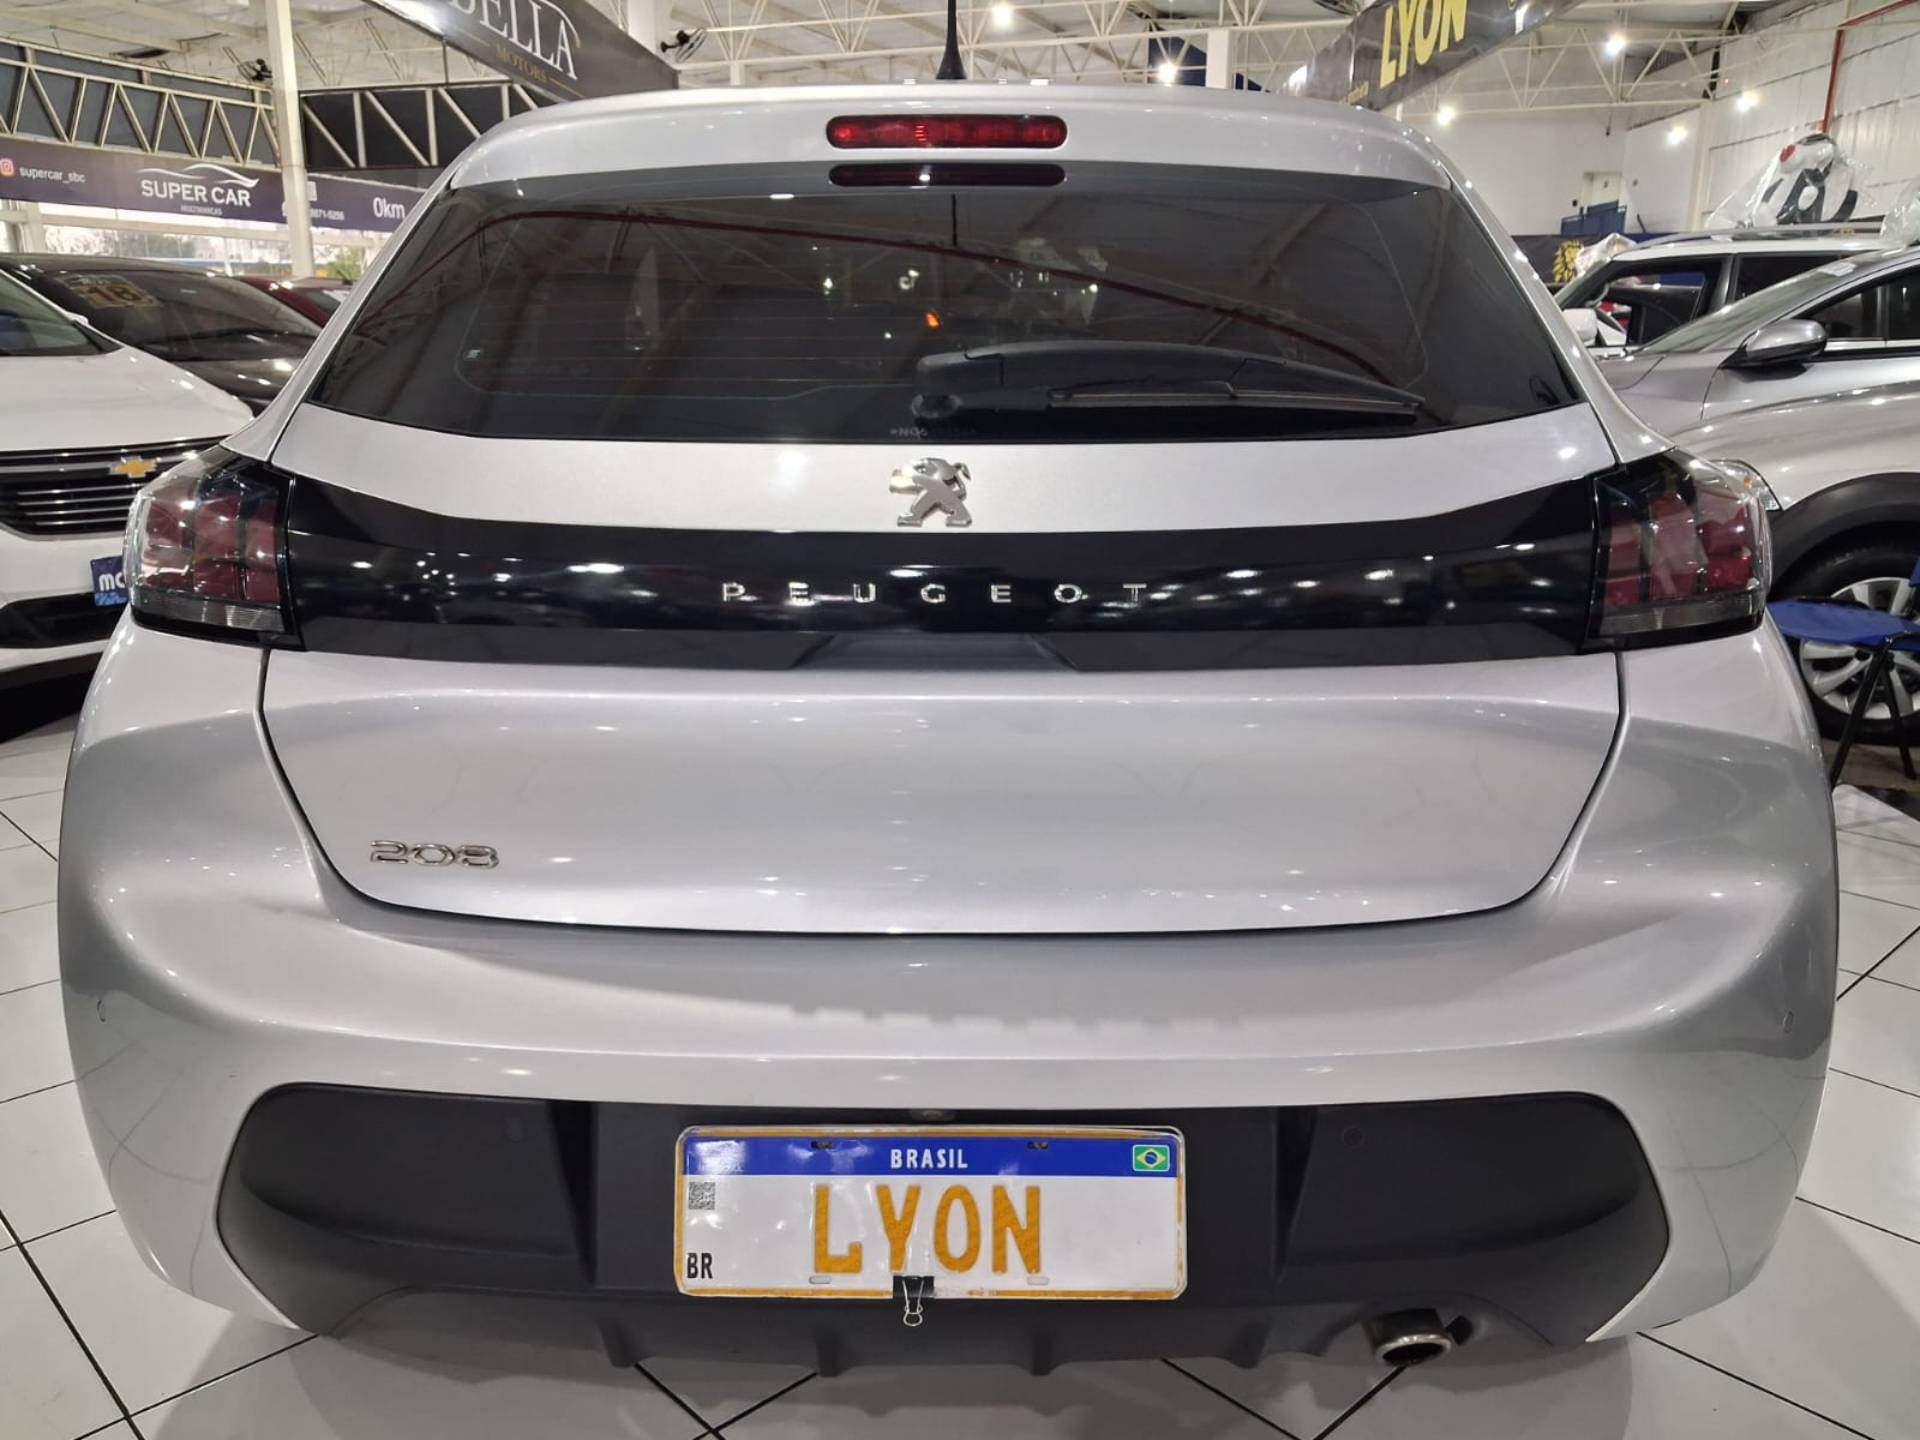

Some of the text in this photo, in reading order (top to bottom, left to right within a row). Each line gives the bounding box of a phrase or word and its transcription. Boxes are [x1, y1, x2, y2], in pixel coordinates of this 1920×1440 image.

[448, 0, 578, 80] ELLA
[1380, 0, 1467, 88] LYON
[19, 165, 86, 184] supercar_sbc
[141, 179, 252, 207] SUPER CAR
[722, 582, 1147, 604] PEUGEOT
[370, 840, 499, 869] 208
[890, 1148, 968, 1170] BRASIL
[813, 1185, 1042, 1275] LYON
[687, 1252, 713, 1280] BR
